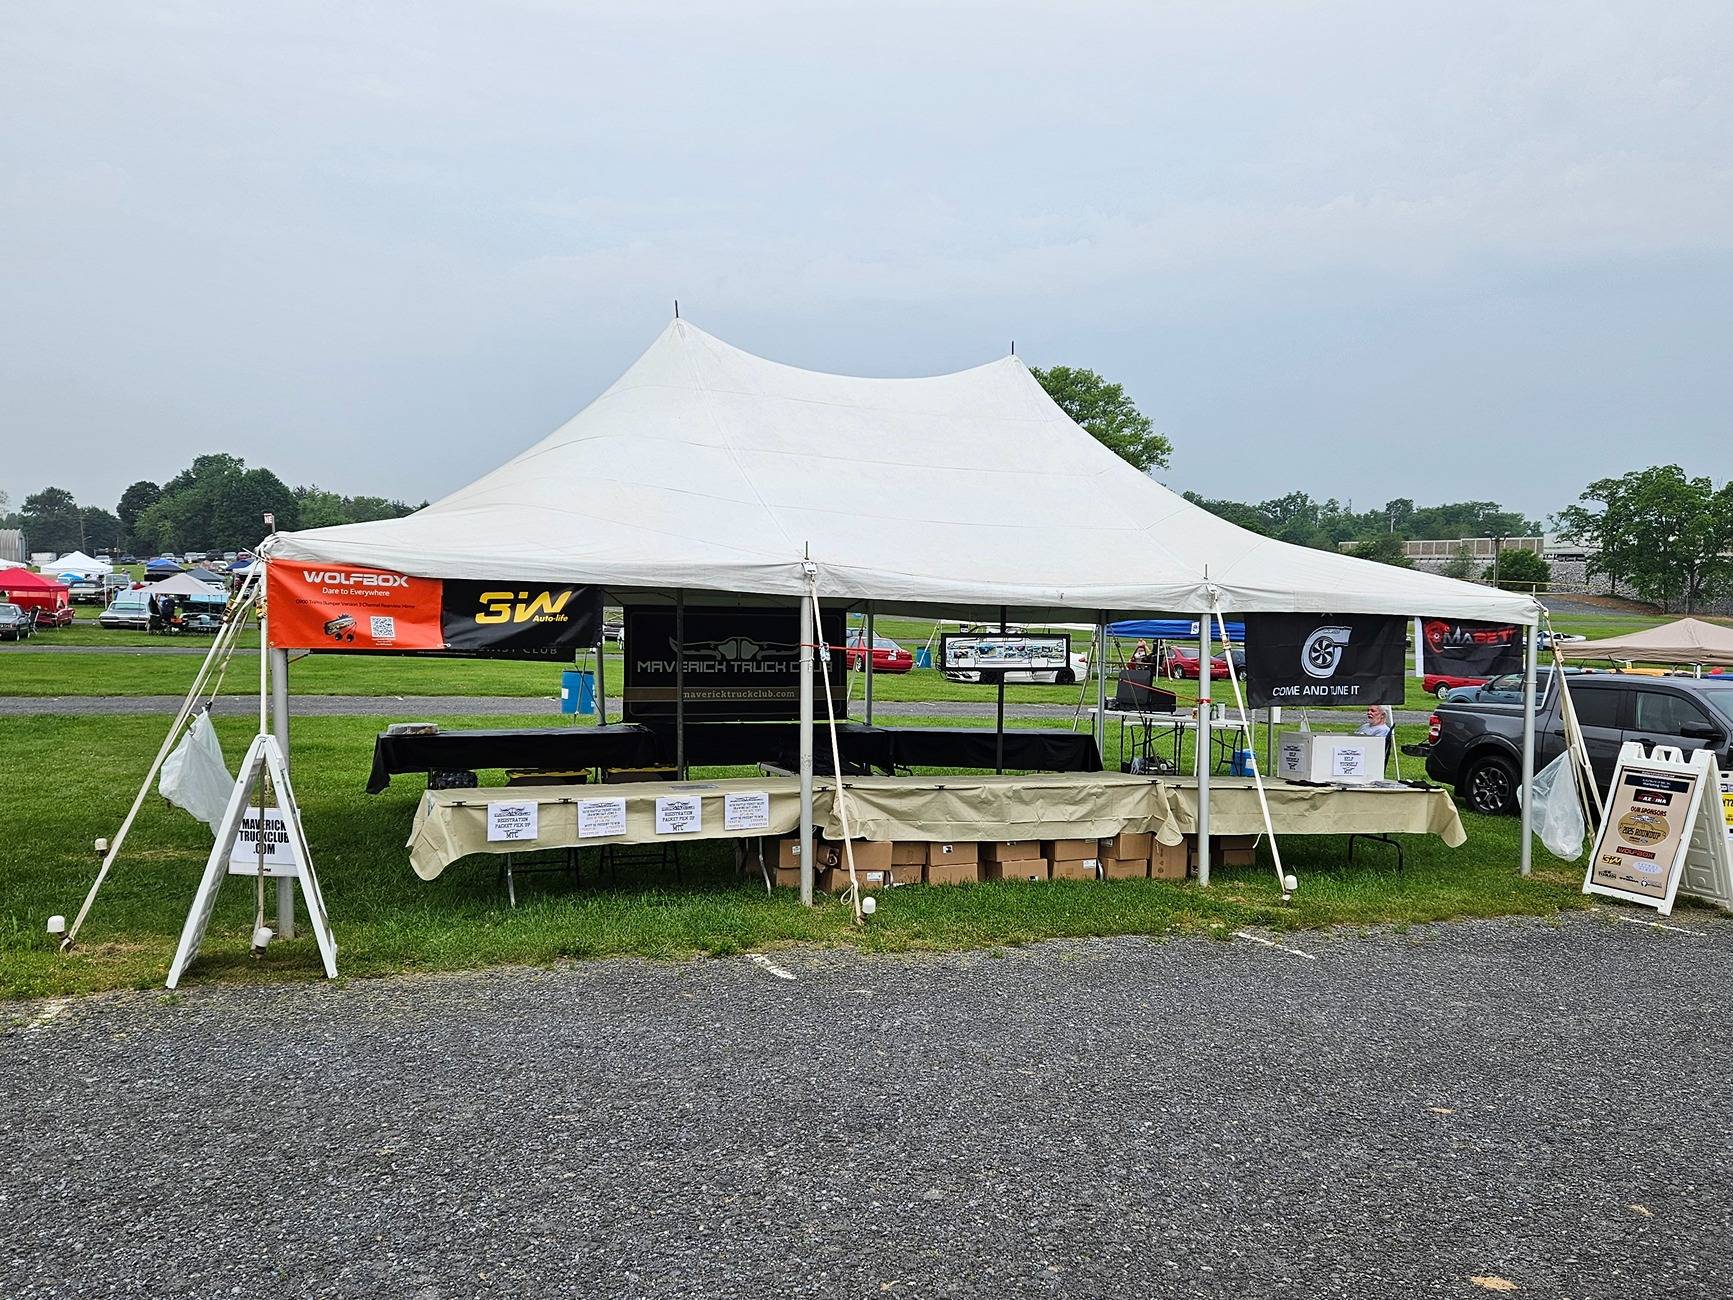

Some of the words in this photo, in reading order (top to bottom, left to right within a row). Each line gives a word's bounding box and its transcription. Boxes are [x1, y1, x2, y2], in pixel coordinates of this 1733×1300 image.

[303, 570, 409, 588] WOLFBOX
[322, 587, 339, 595] Dare
[350, 588, 390, 597] Everywhere
[533, 614, 568, 622] Auto-life
[637, 661, 727, 673] MAVERICK
[730, 661, 786, 673] TRUCK
[790, 661, 833, 673] CUB
[1272, 686, 1300, 696] COME
[1302, 686, 1329, 695] AND
[1330, 686, 1349, 695] TUNE
[1351, 686, 1360, 695] IT
[1640, 807, 1668, 817] SPONSORS
[242, 818, 287, 831] MAVRICK
